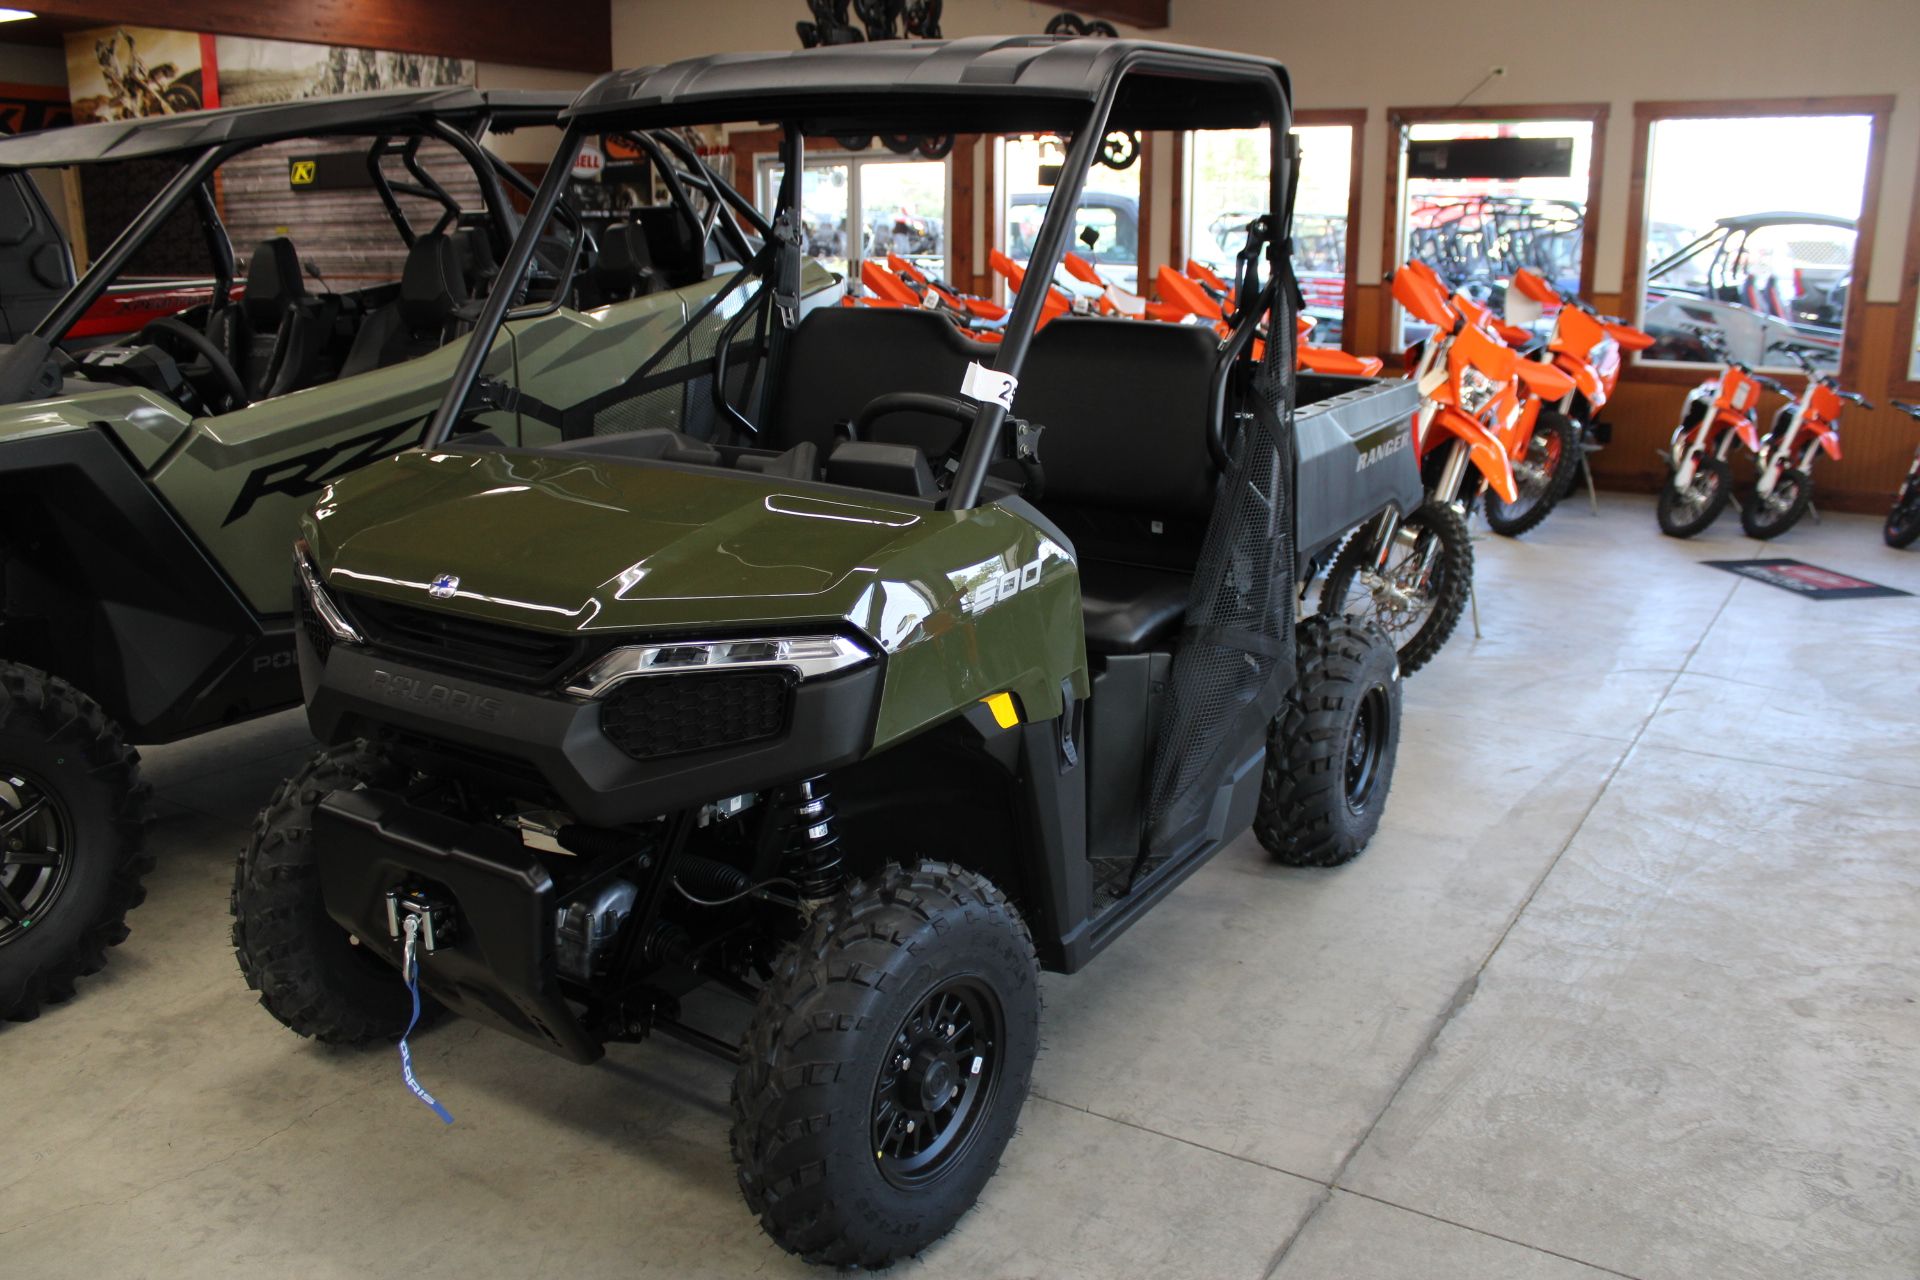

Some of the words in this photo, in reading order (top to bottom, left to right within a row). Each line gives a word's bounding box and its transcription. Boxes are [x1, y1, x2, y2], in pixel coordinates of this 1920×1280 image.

[1356, 431, 1410, 472] RANGER
[972, 559, 1042, 614] 500
[369, 669, 503, 723] POLARIS
